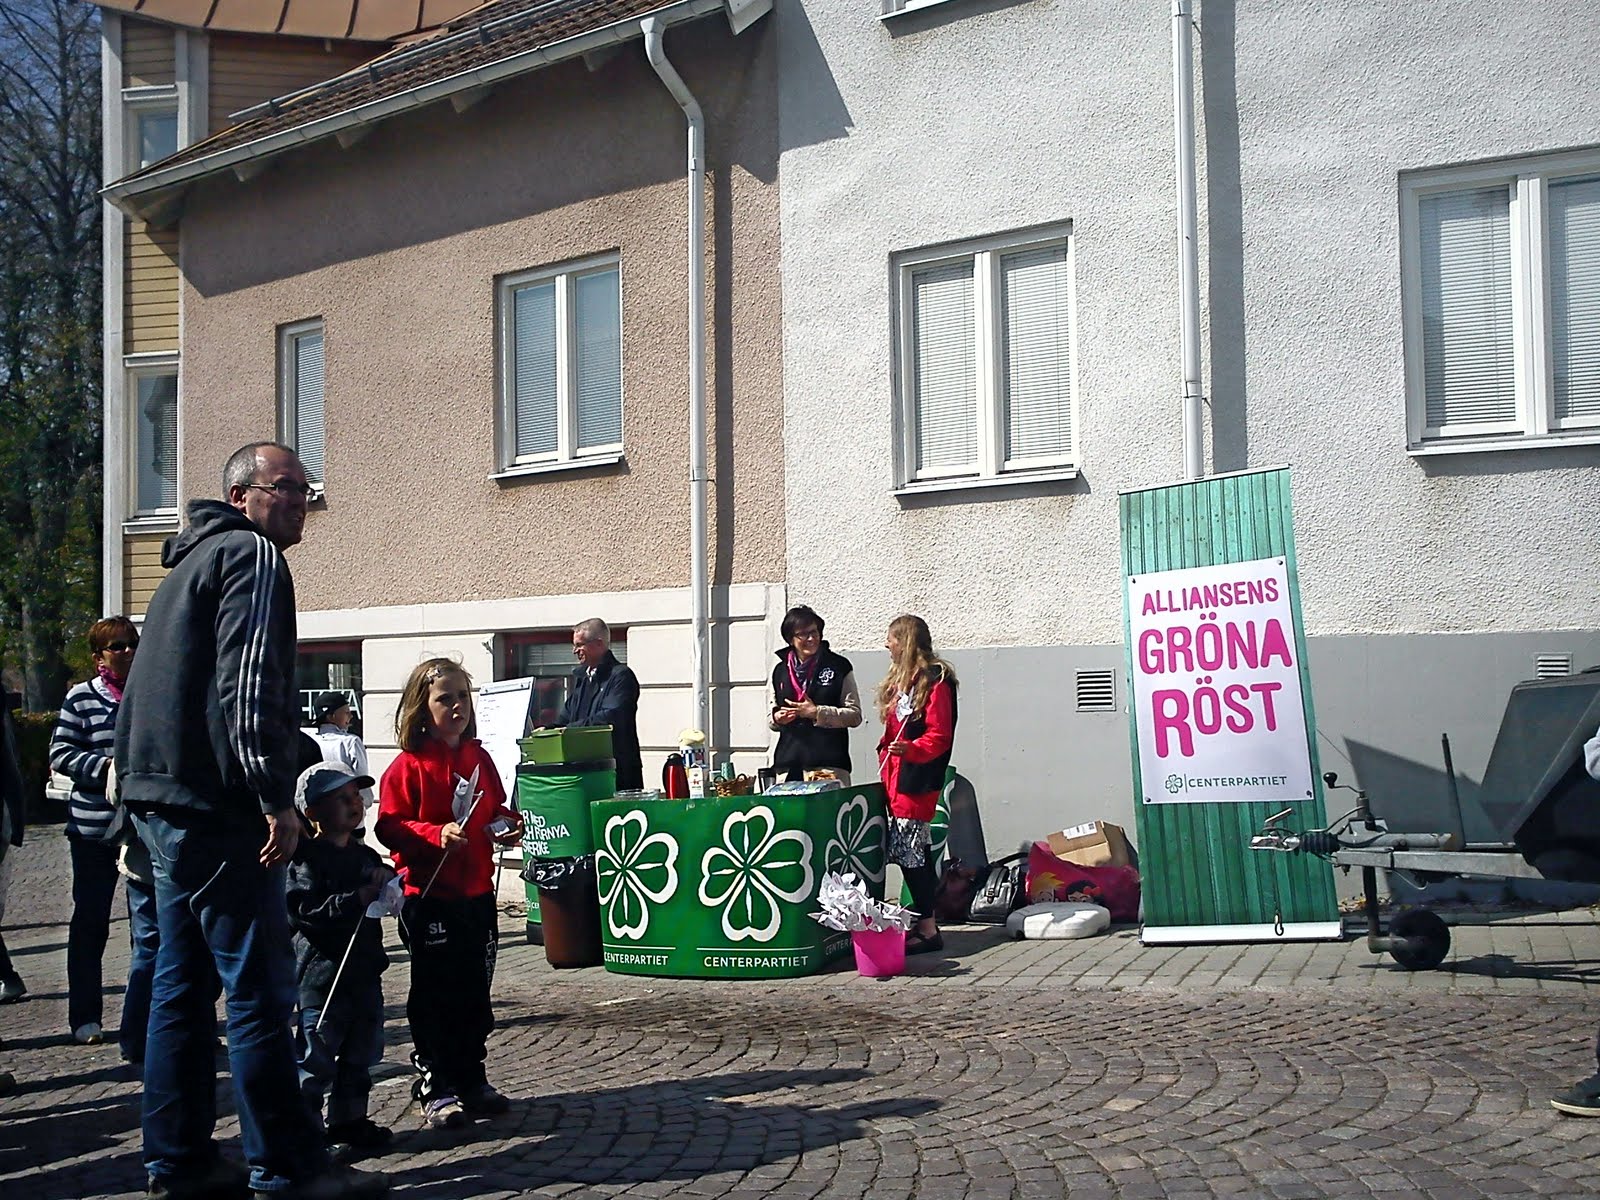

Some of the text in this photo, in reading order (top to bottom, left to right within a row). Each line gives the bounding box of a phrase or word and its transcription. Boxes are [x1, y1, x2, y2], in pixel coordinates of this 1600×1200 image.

[1142, 577, 1279, 616] ALLIANSENS
[1138, 611, 1292, 674] GRÖNA
[1151, 675, 1283, 758] RÖST
[1188, 775, 1287, 788] CENTERPARTIET
[428, 922, 447, 935] SL
[604, 951, 669, 966] CENTERPARTIET
[703, 955, 809, 968] CENTERPARTIET
